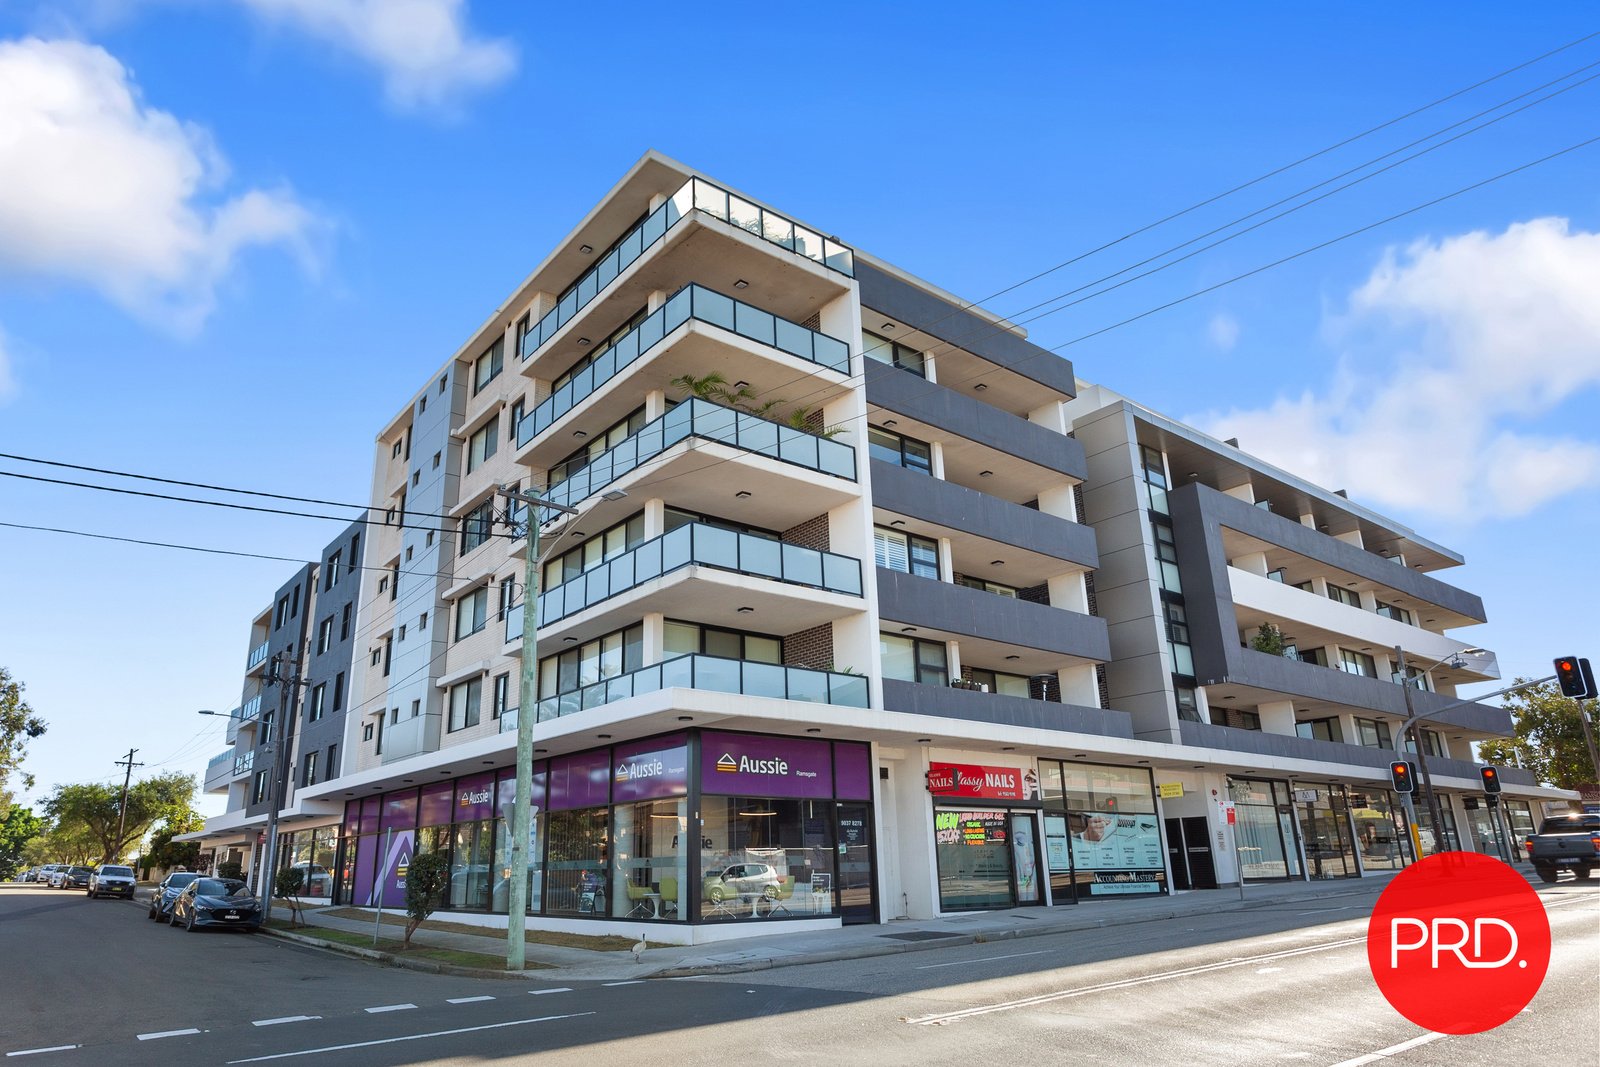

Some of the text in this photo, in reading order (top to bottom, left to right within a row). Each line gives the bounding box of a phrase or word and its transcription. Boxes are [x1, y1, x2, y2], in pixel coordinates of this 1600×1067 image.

[630, 759, 663, 779] Aussie
[739, 755, 788, 775] Aussie
[929, 777, 954, 788] NAILS
[985, 773, 1014, 788] NAILS
[469, 789, 489, 805] Aussie
[936, 812, 959, 830] NEW
